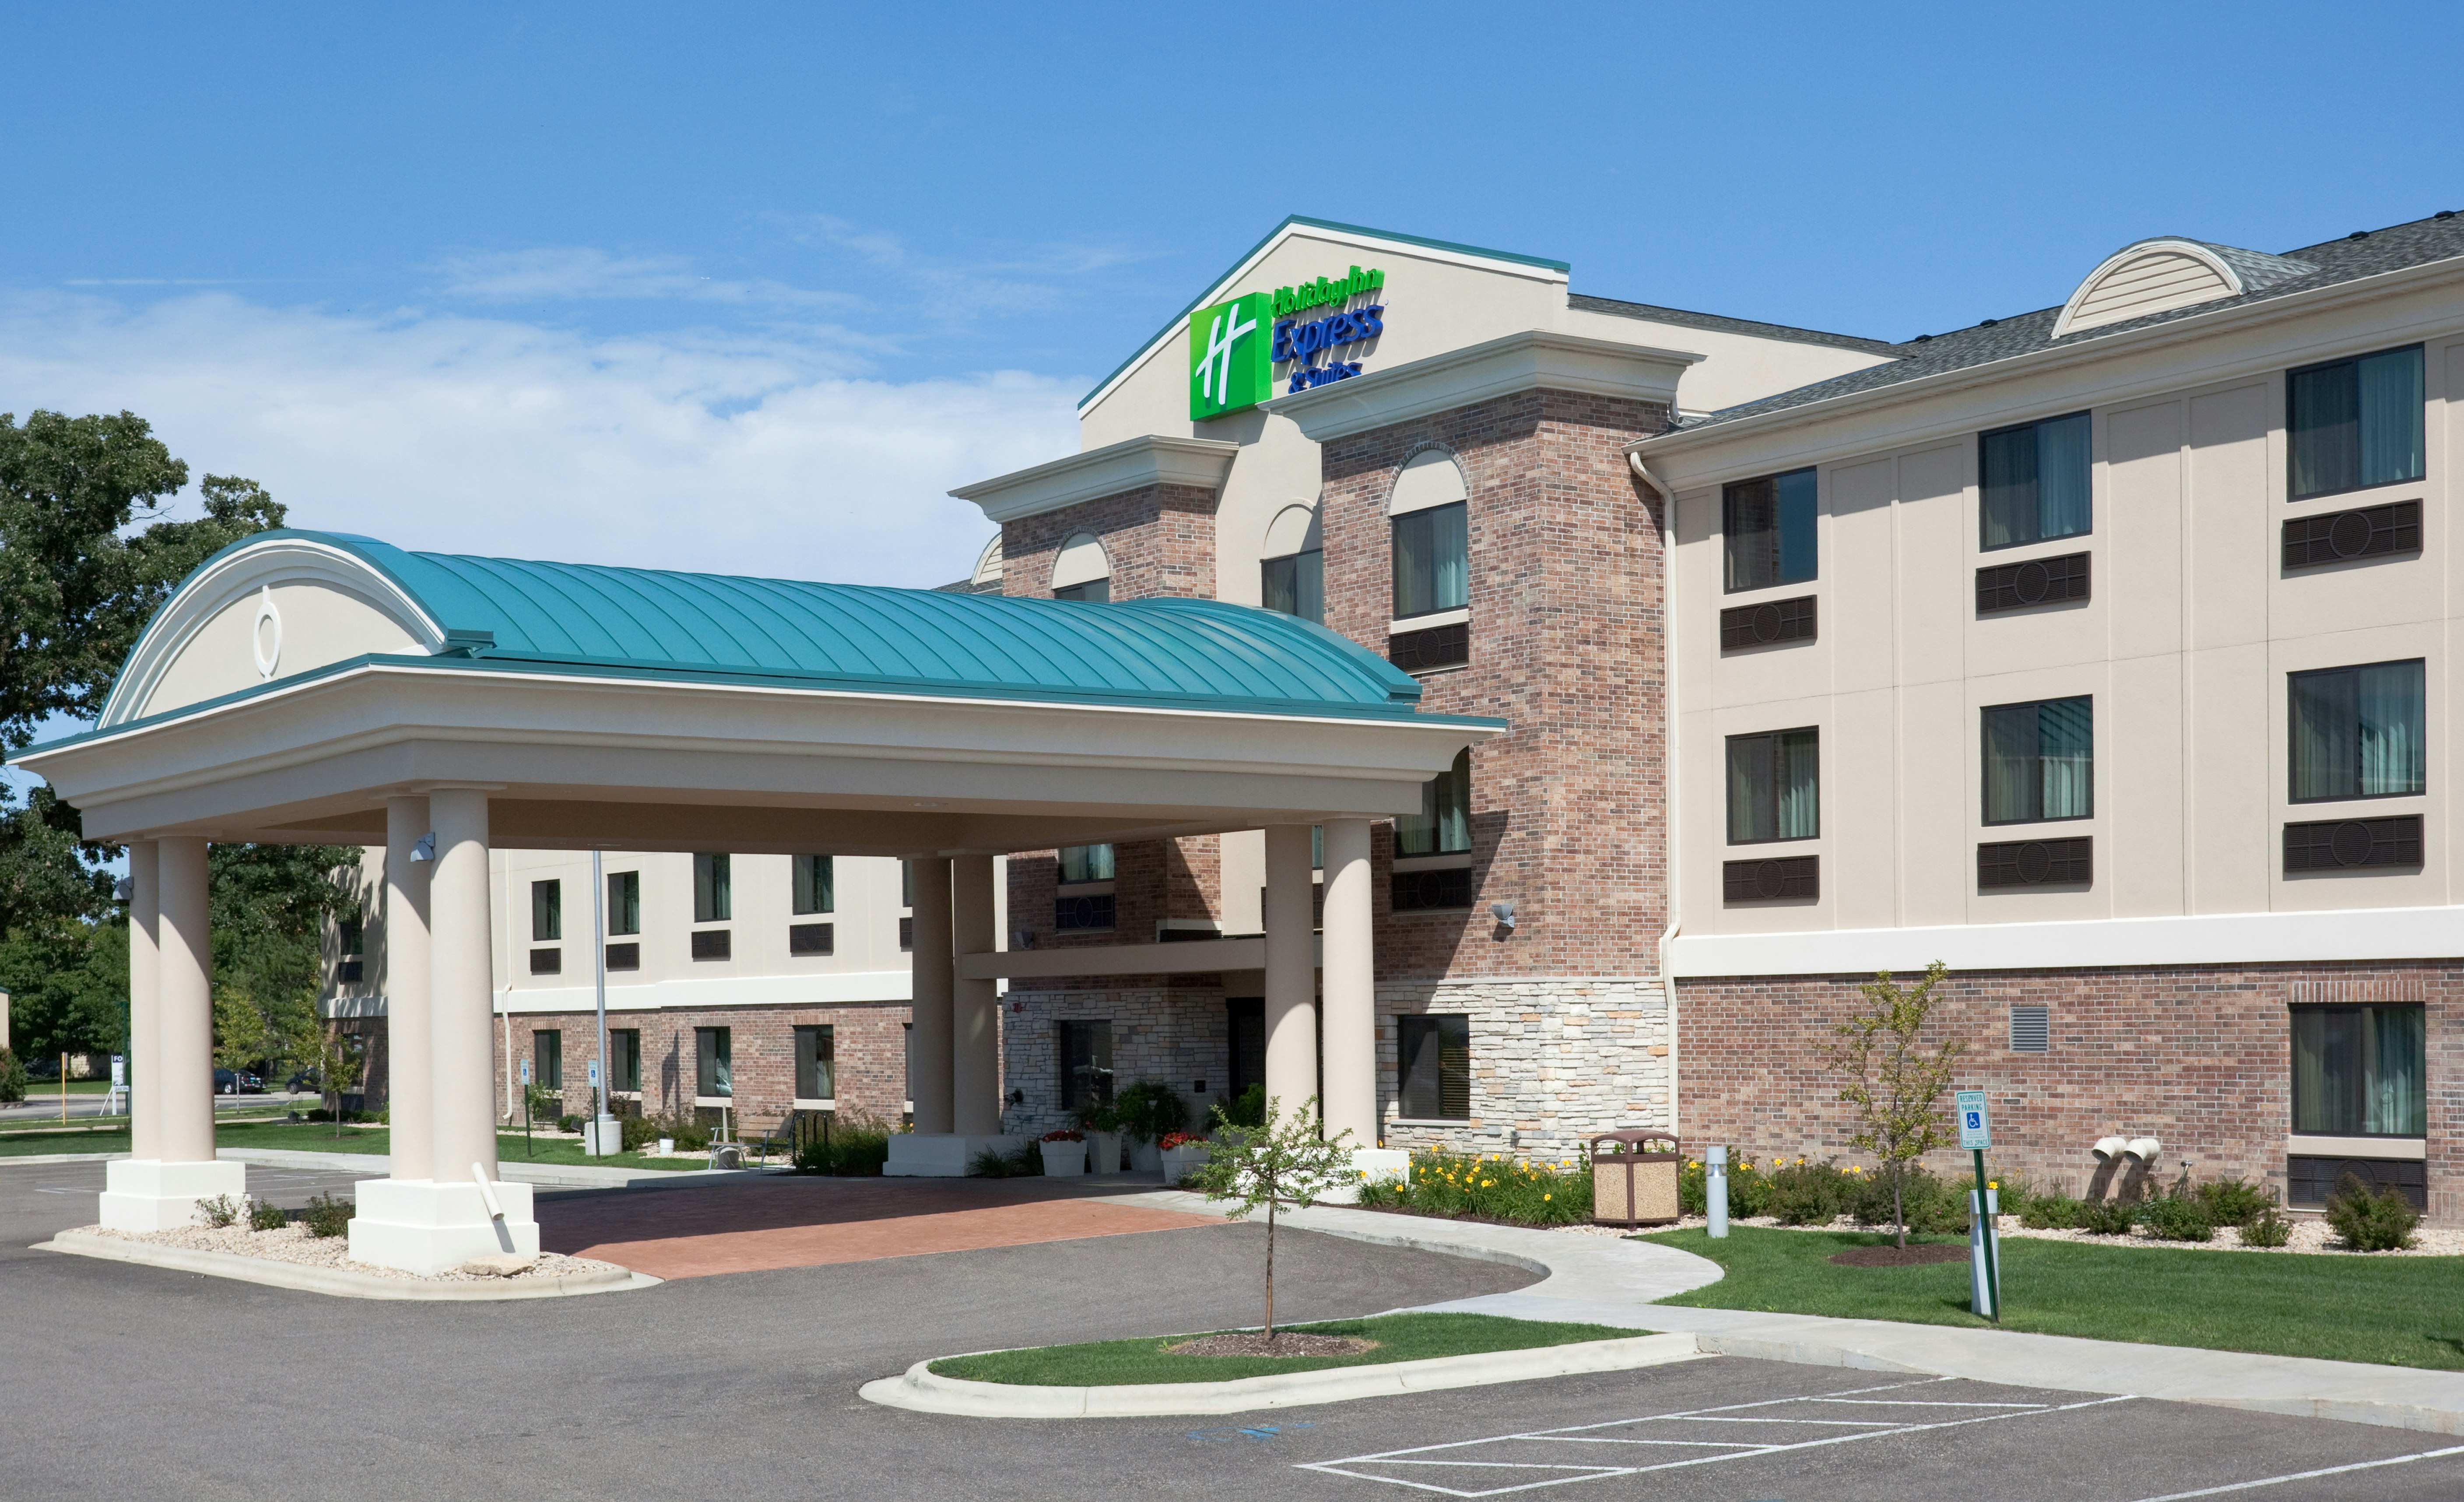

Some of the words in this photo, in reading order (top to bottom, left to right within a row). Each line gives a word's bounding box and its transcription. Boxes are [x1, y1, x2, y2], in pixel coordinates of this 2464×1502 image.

[1271, 276, 1349, 318] Holiday
[1346, 265, 1385, 295] Inn
[1271, 304, 1384, 365] Express
[1288, 372, 1308, 394] &
[1305, 362, 1363, 389] Suites
[1960, 1094, 1982, 1103] RESERVED
[1962, 1103, 1982, 1112] PARKING
